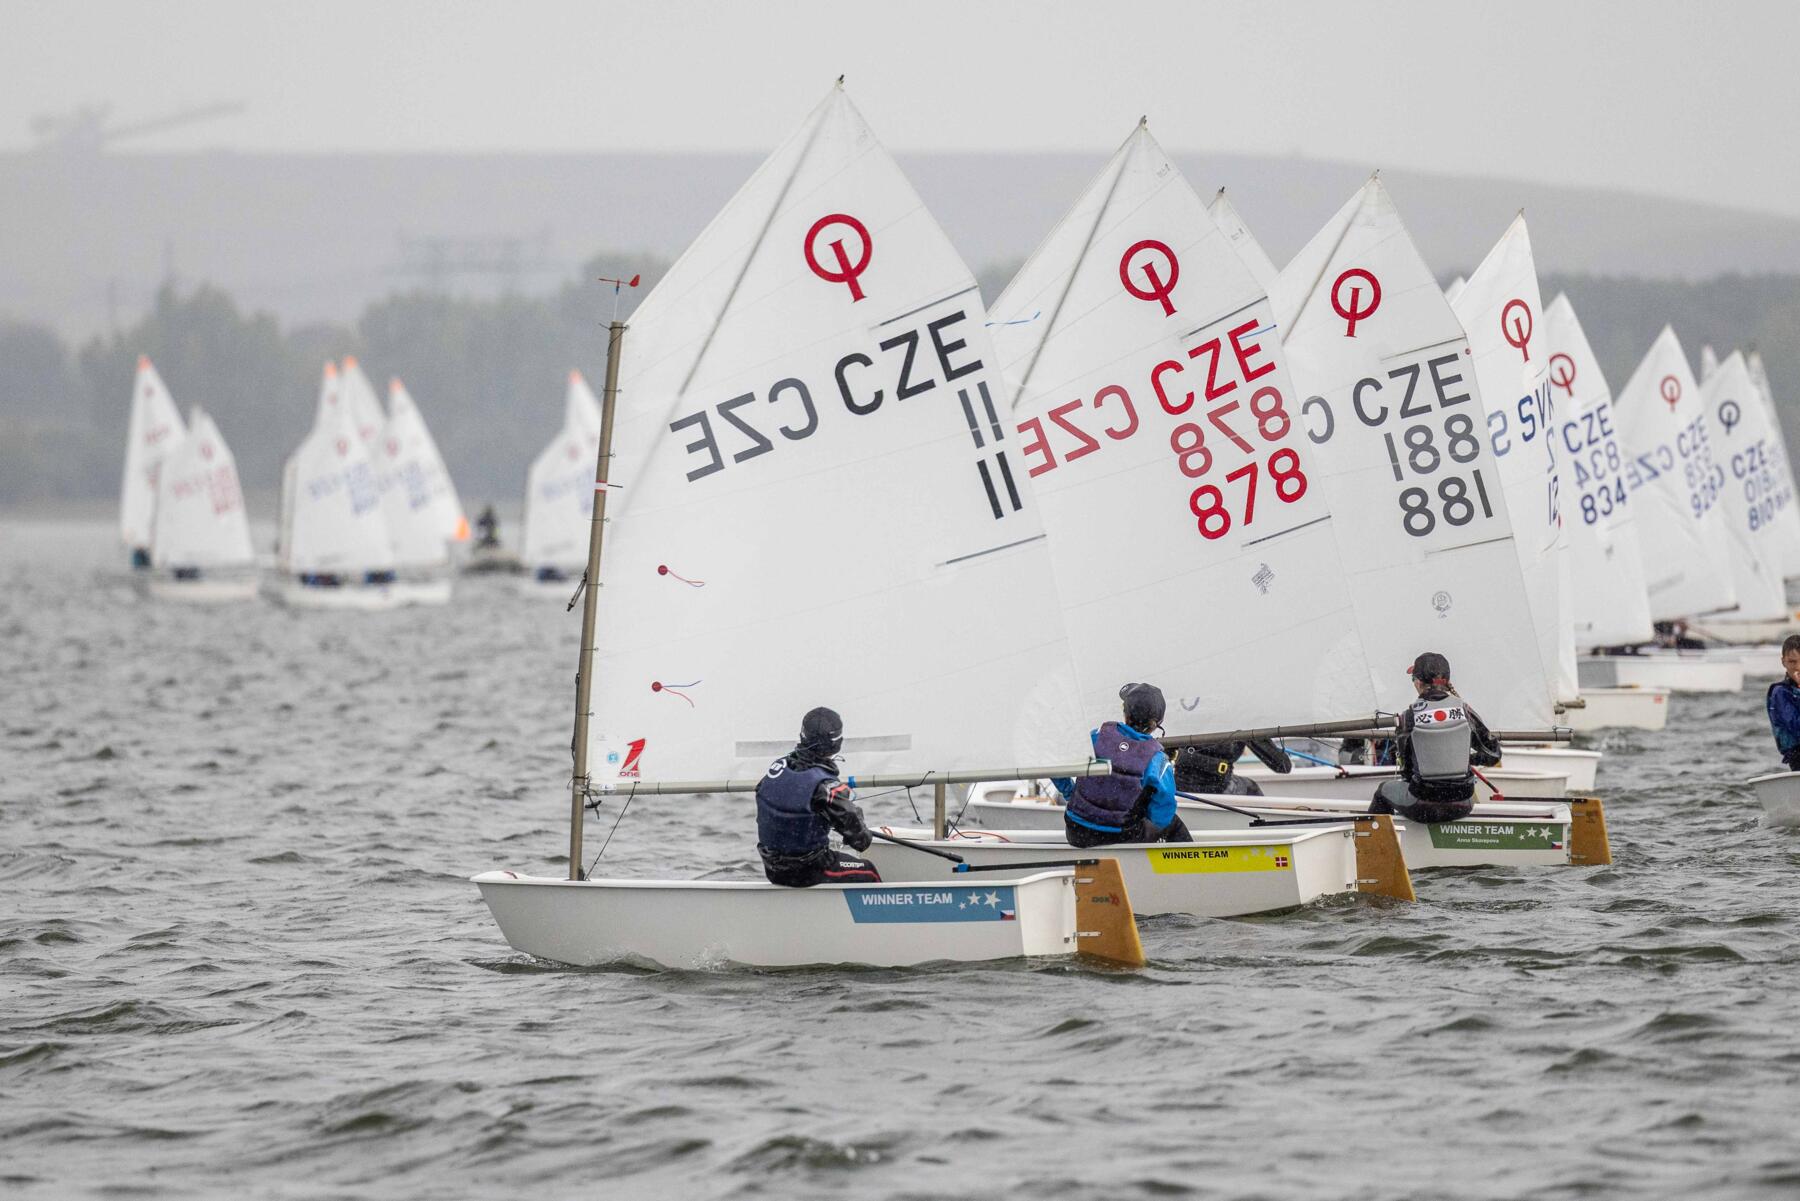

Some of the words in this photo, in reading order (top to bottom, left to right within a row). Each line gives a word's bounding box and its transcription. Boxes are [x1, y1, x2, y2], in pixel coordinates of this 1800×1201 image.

[834, 310, 984, 416] CZE
[1150, 318, 1276, 416] CZE
[1352, 353, 1472, 427] CZE
[1562, 403, 1613, 453] CZE
[1676, 414, 1709, 459] CZE
[1731, 439, 1767, 479] CZE
[976, 451, 1023, 520] 11
[1189, 447, 1308, 540] 878
[1398, 468, 1493, 537] 881
[1580, 475, 1628, 525] 834
[1439, 824, 1482, 835] WINNER
[1485, 825, 1514, 835] TEAM
[1162, 851, 1200, 860] WINNER
[1202, 850, 1229, 859] TEAM
[861, 893, 913, 906] WINNER
[916, 892, 953, 905] TEAM
